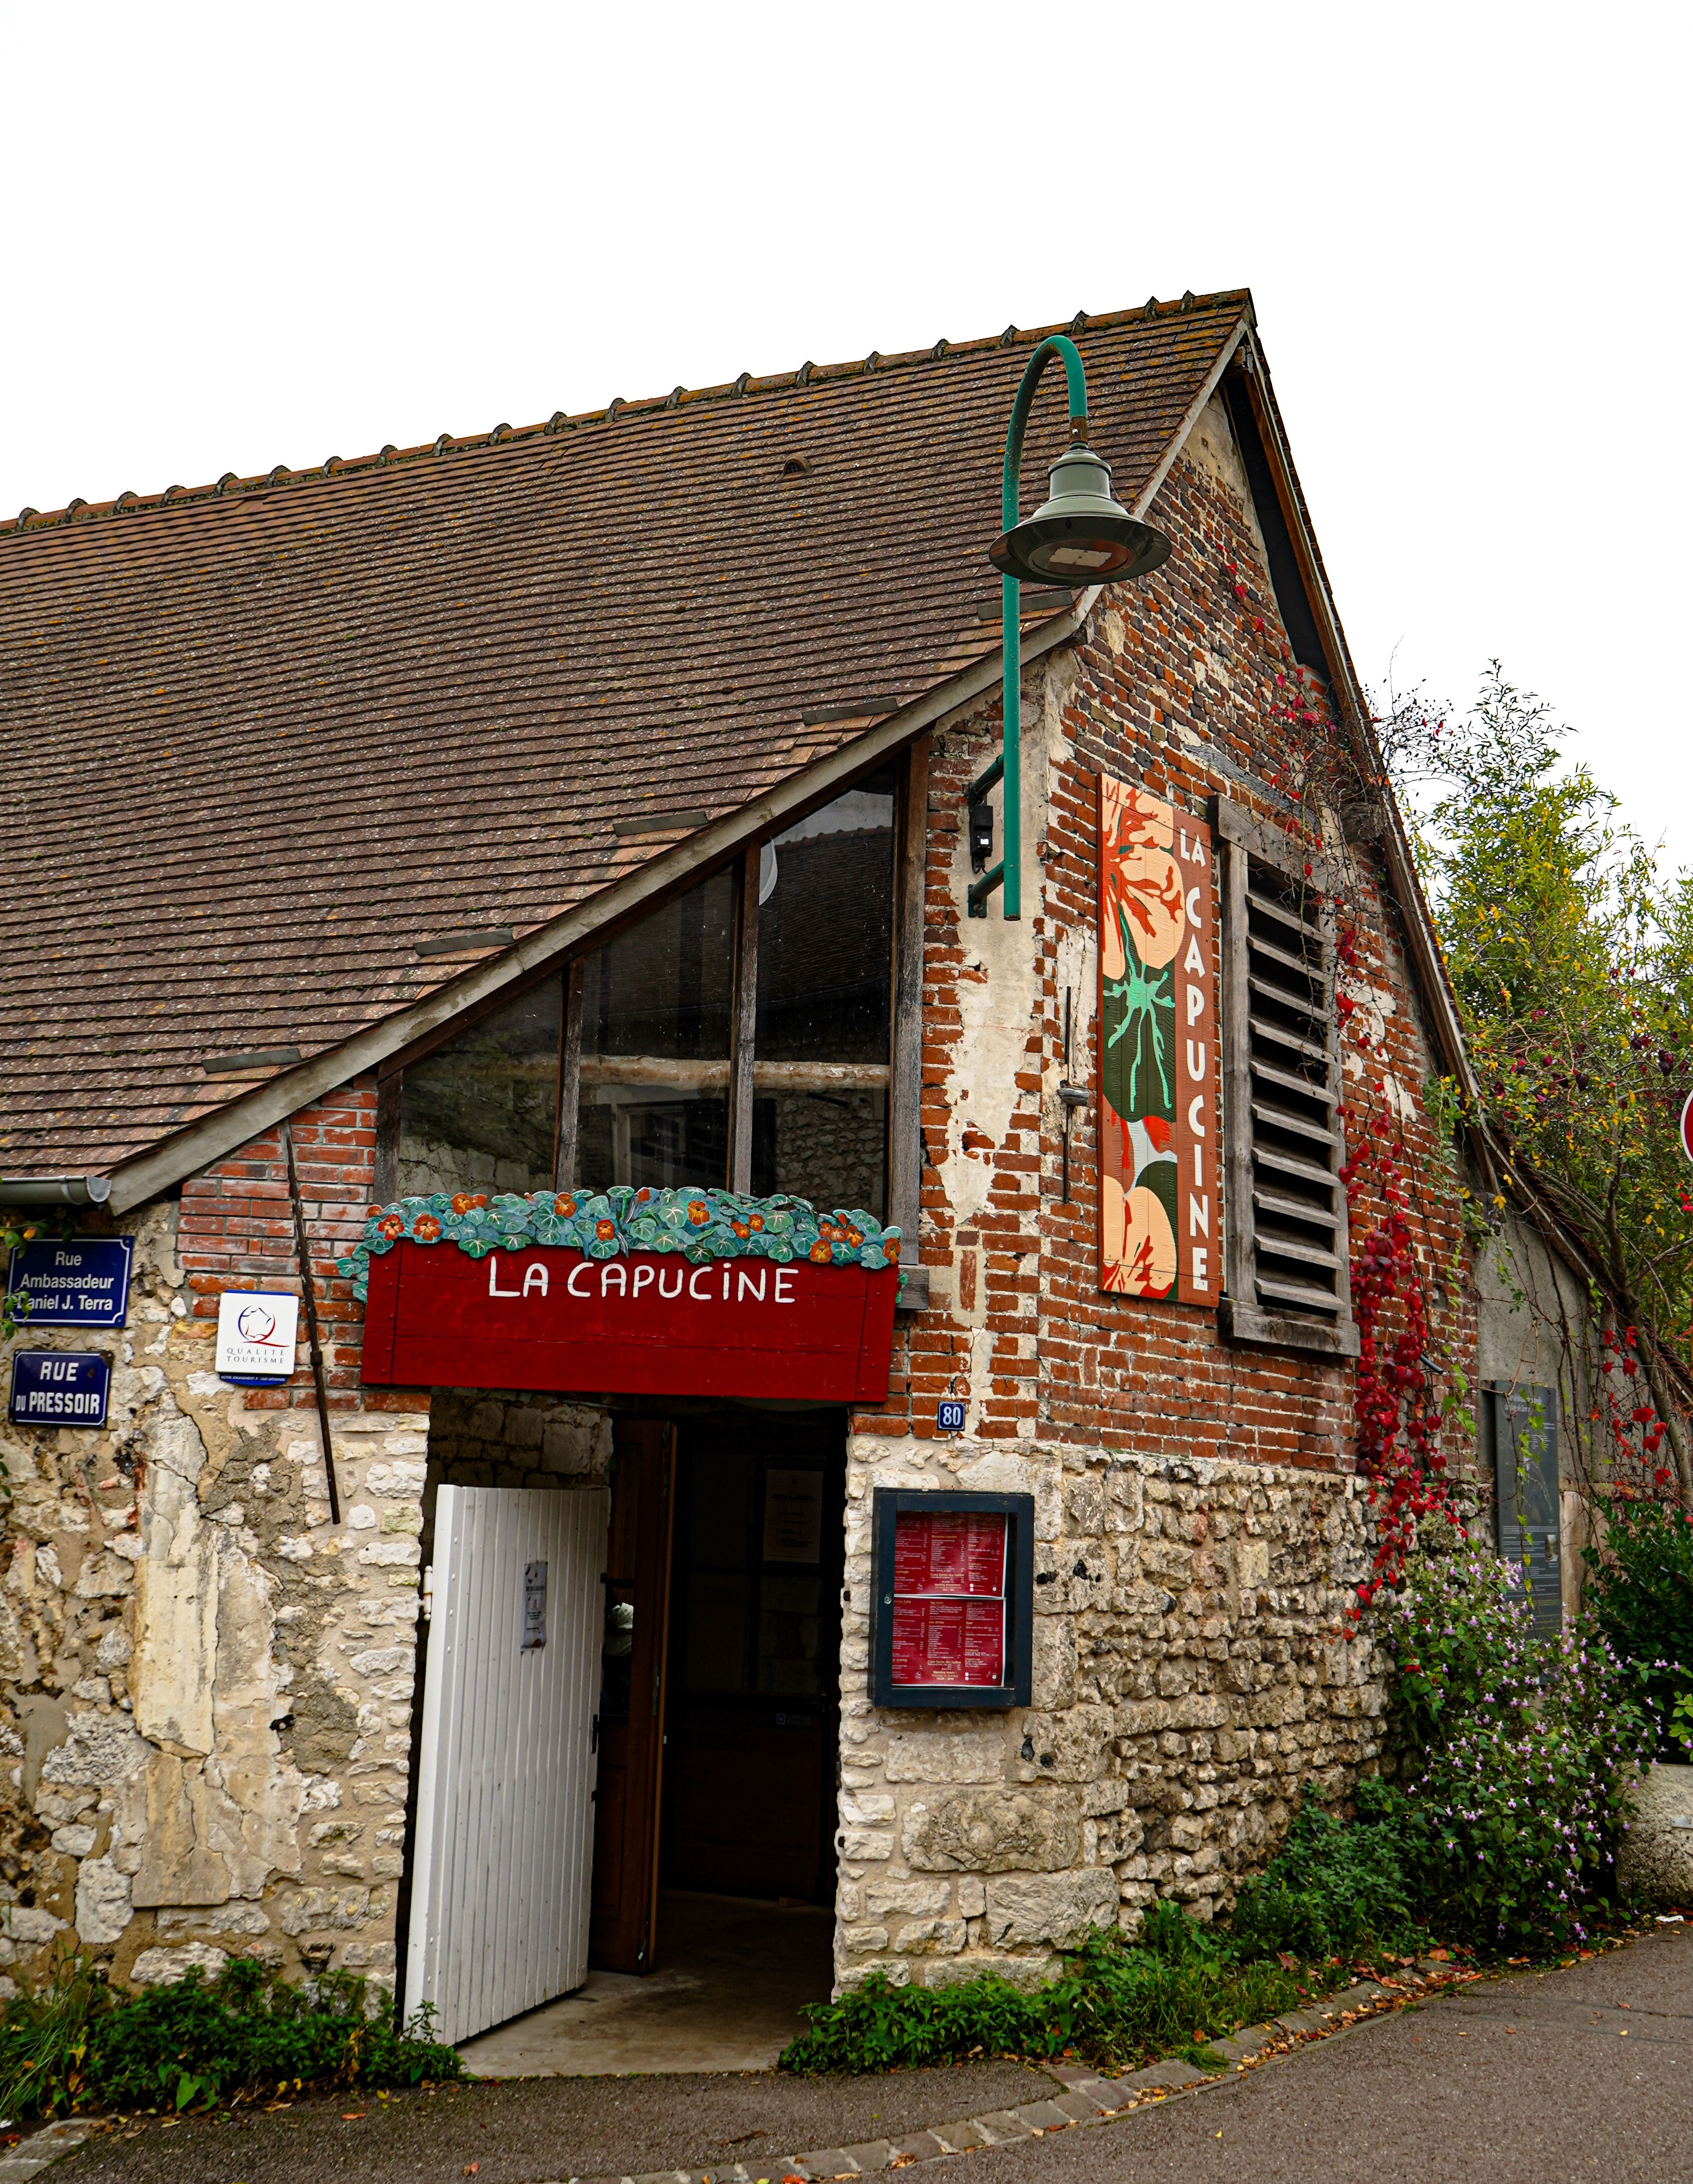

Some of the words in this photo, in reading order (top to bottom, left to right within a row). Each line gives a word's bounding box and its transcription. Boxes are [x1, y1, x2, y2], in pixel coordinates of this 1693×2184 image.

[1180, 828, 1206, 868] LA
[1184, 886, 1209, 1292] CAPUCINE
[55, 1252, 82, 1266] Rue
[20, 1274, 114, 1289] Ambassadeur
[489, 1256, 549, 1297] LA
[62, 1295, 74, 1310] J.
[78, 1295, 113, 1310] Terra
[227, 1347, 284, 1356] QUALITÉ
[40, 1361, 79, 1381] RUE
[15, 1395, 26, 1412] DU
[29, 1391, 100, 1415] PRESSOIR
[943, 1406, 961, 1426] 80
